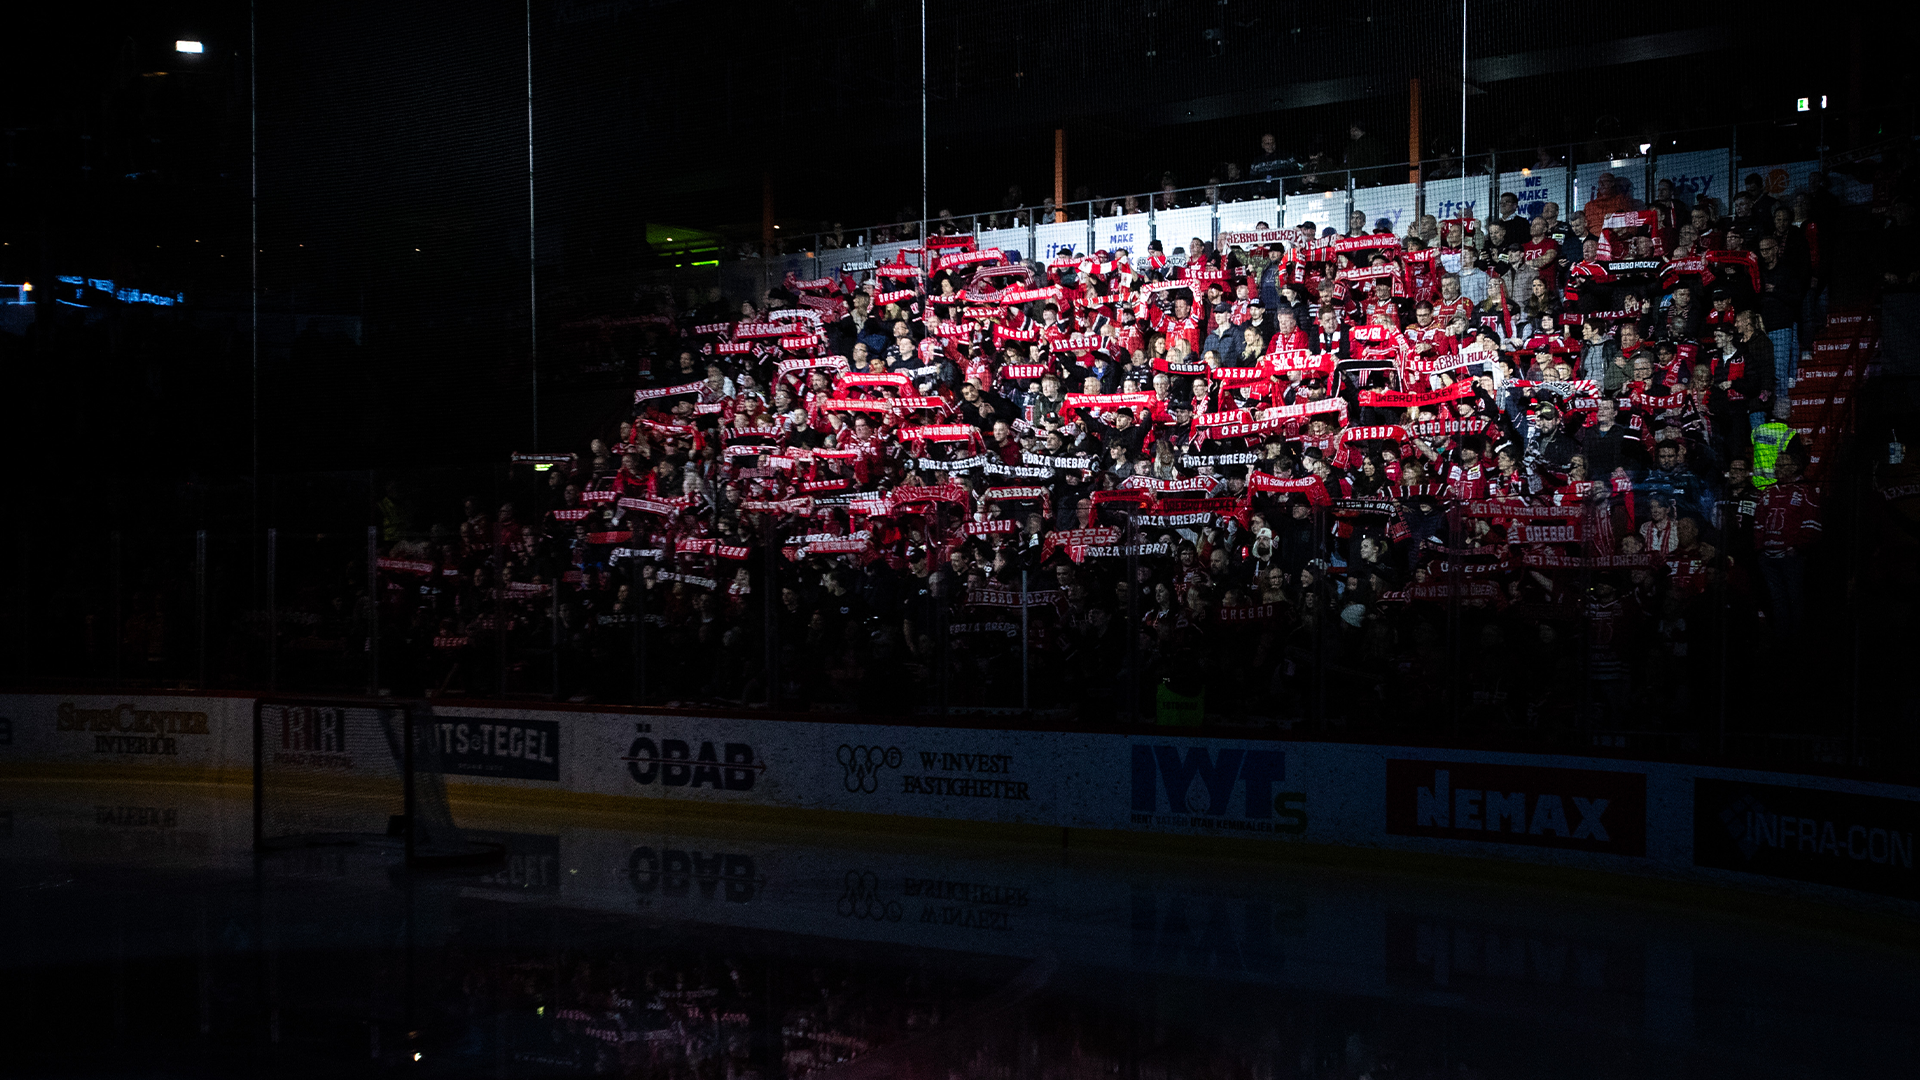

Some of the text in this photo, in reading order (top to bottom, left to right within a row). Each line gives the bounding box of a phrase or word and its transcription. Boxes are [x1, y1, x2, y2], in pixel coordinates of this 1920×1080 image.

[1525, 177, 1541, 187] WE
[1518, 189, 1548, 201] MAKE
[1115, 222, 1128, 231] WE
[1110, 233, 1133, 243] MAKE
[1445, 419, 1488, 433] HOCKEY
[94, 735, 178, 755] INTERIOR
[628, 723, 756, 791] ÖBAB
[903, 775, 1030, 801] FASTIGHETER
[1416, 769, 1611, 843] NEMAX
[1190, 817, 1214, 829] UTAN
[1216, 818, 1272, 832] KEMIKALIER
